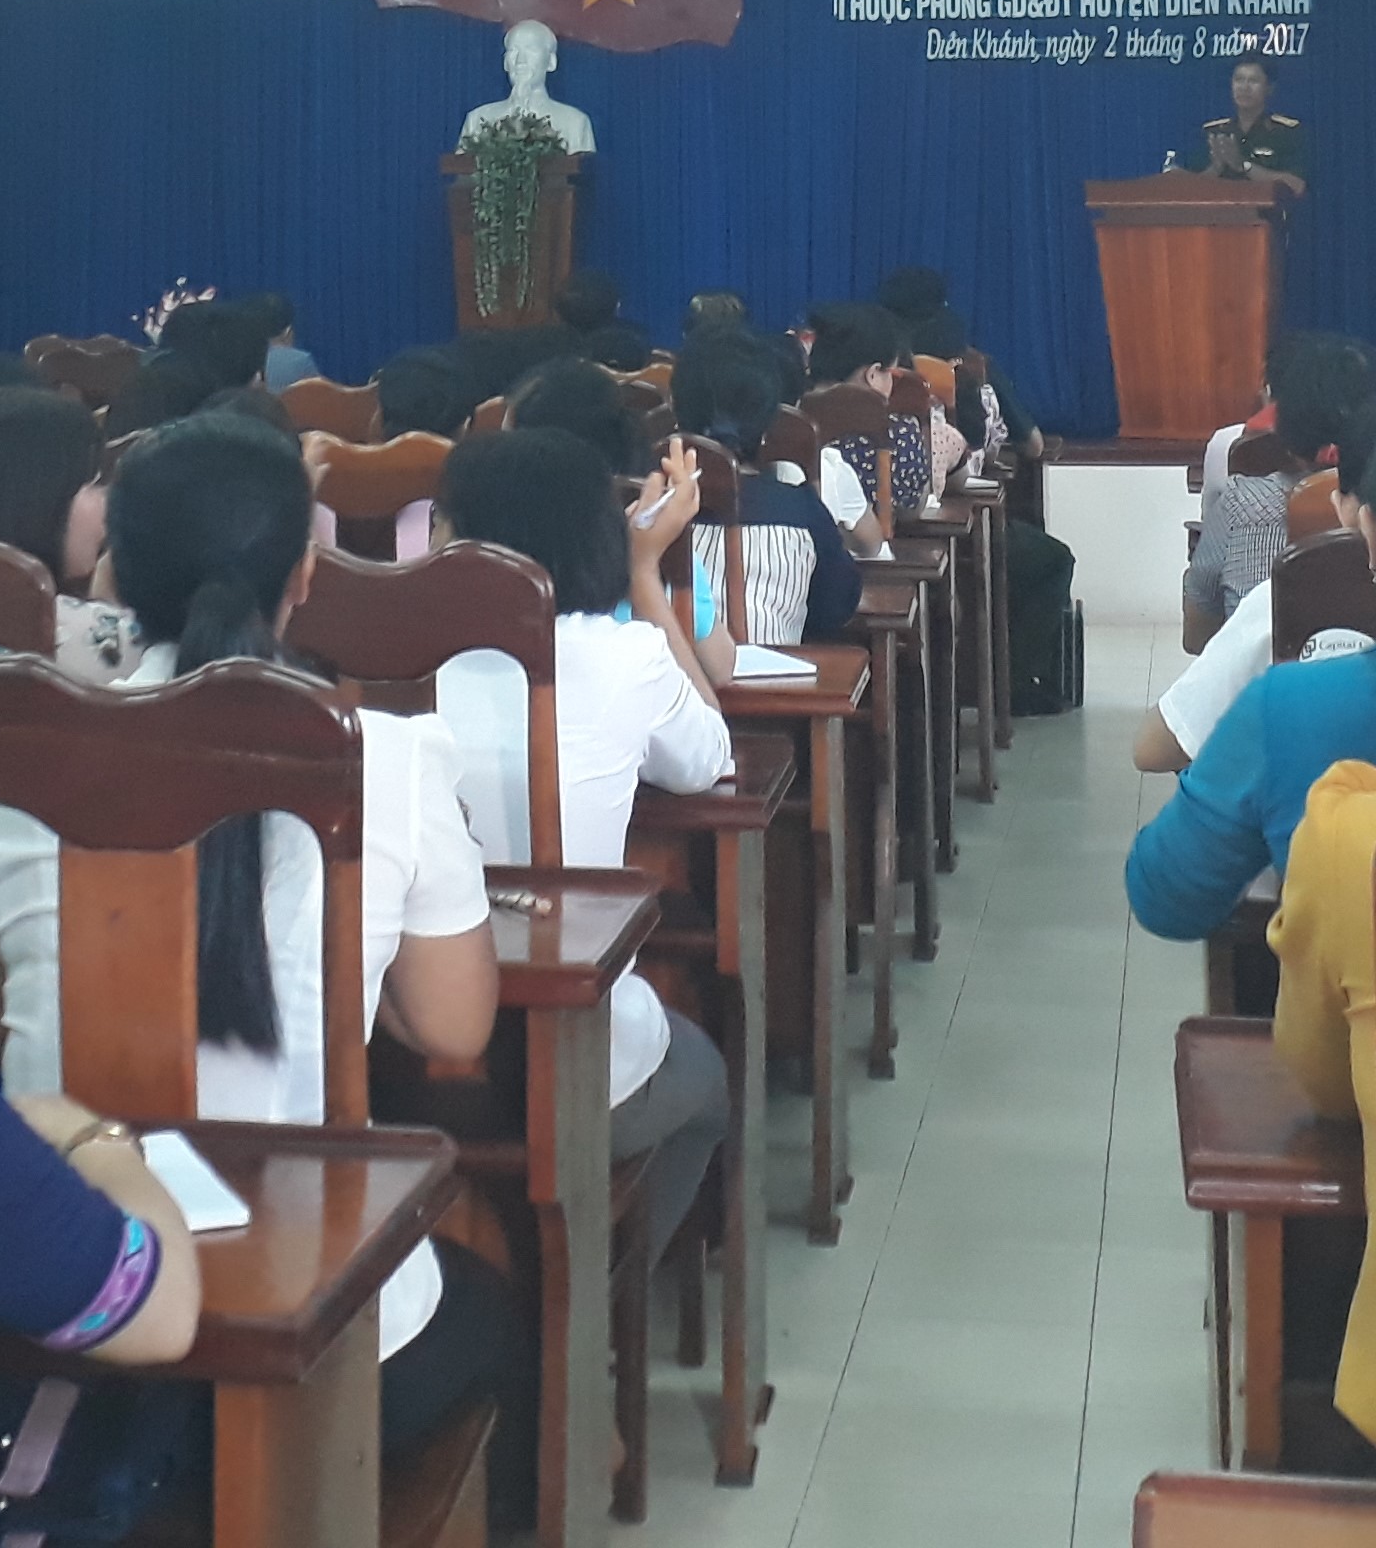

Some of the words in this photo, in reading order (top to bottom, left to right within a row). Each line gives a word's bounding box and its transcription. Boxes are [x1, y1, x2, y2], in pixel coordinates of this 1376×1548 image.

[972, 28, 1040, 64] Khánh,
[1045, 29, 1096, 65] ngày
[1104, 26, 1119, 58] 2
[1126, 28, 1184, 64] tháng
[1193, 26, 1207, 58] 8
[1212, 27, 1258, 56] năm
[1262, 23, 1309, 56] 2017
